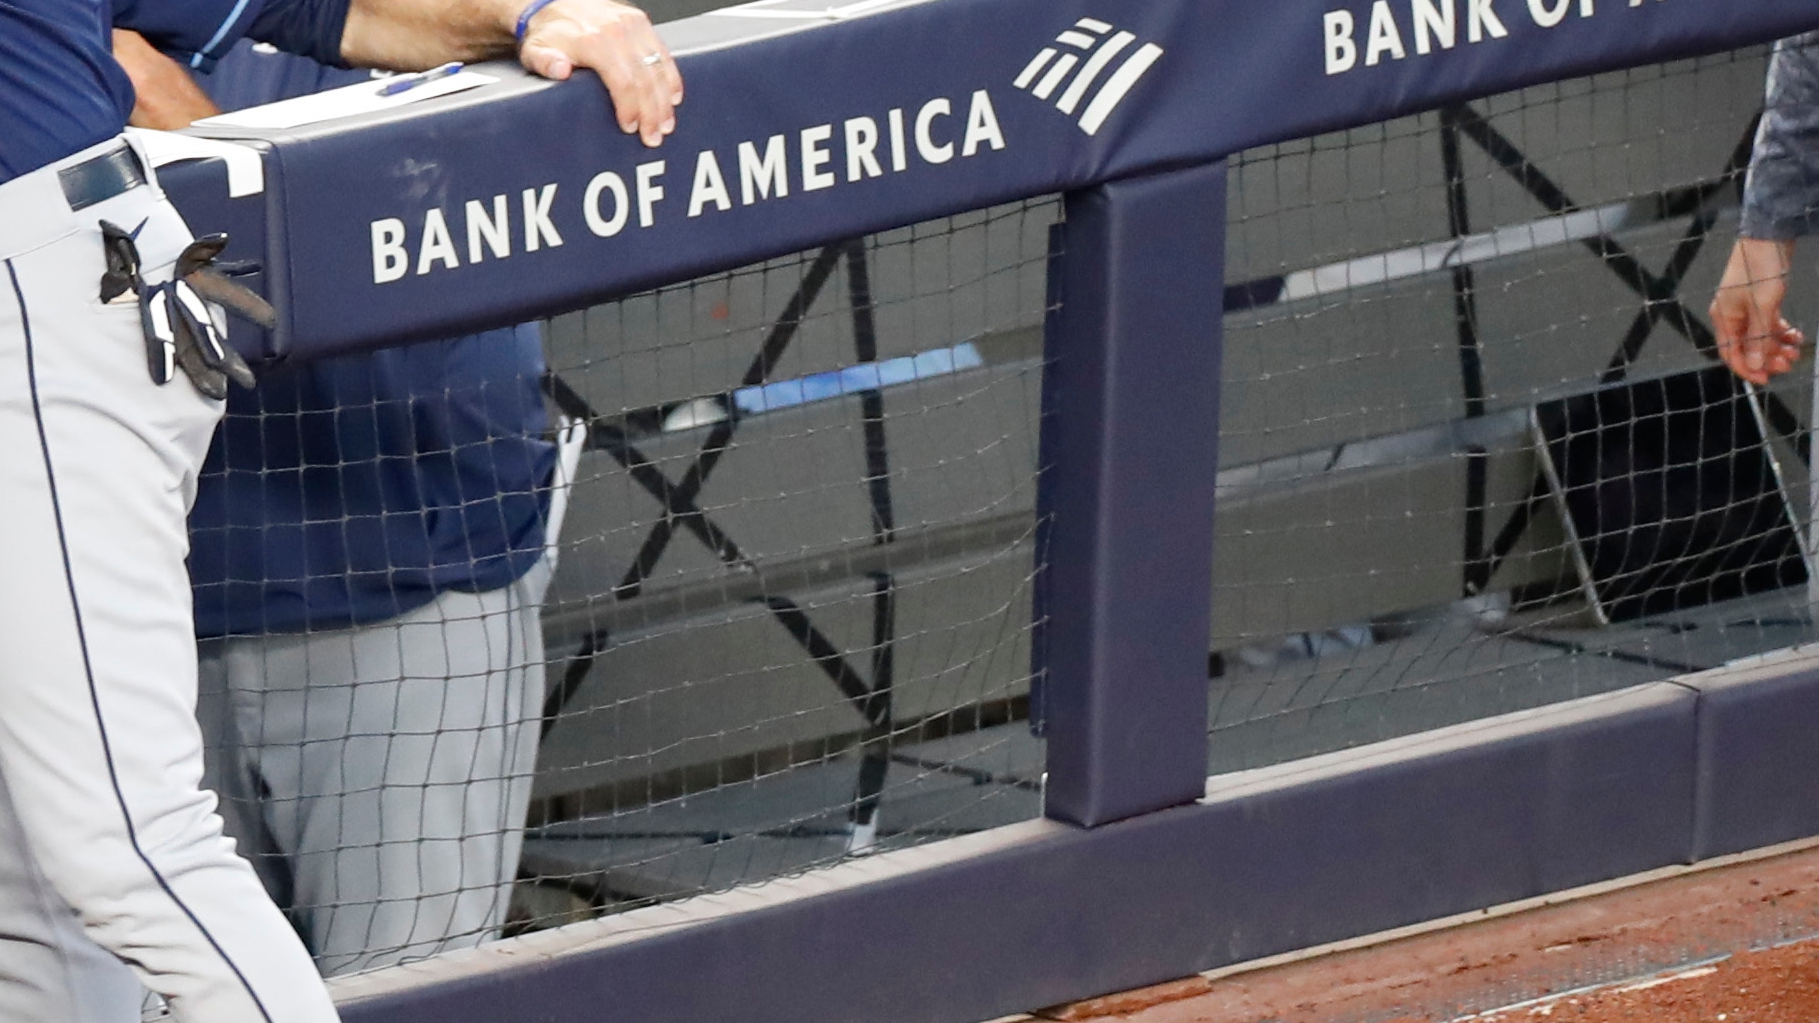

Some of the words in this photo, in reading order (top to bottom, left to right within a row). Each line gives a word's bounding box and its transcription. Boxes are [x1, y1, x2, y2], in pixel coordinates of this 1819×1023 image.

[371, 183, 563, 284] BANK
[583, 160, 666, 237] OF
[687, 89, 1005, 217] AMERICA
